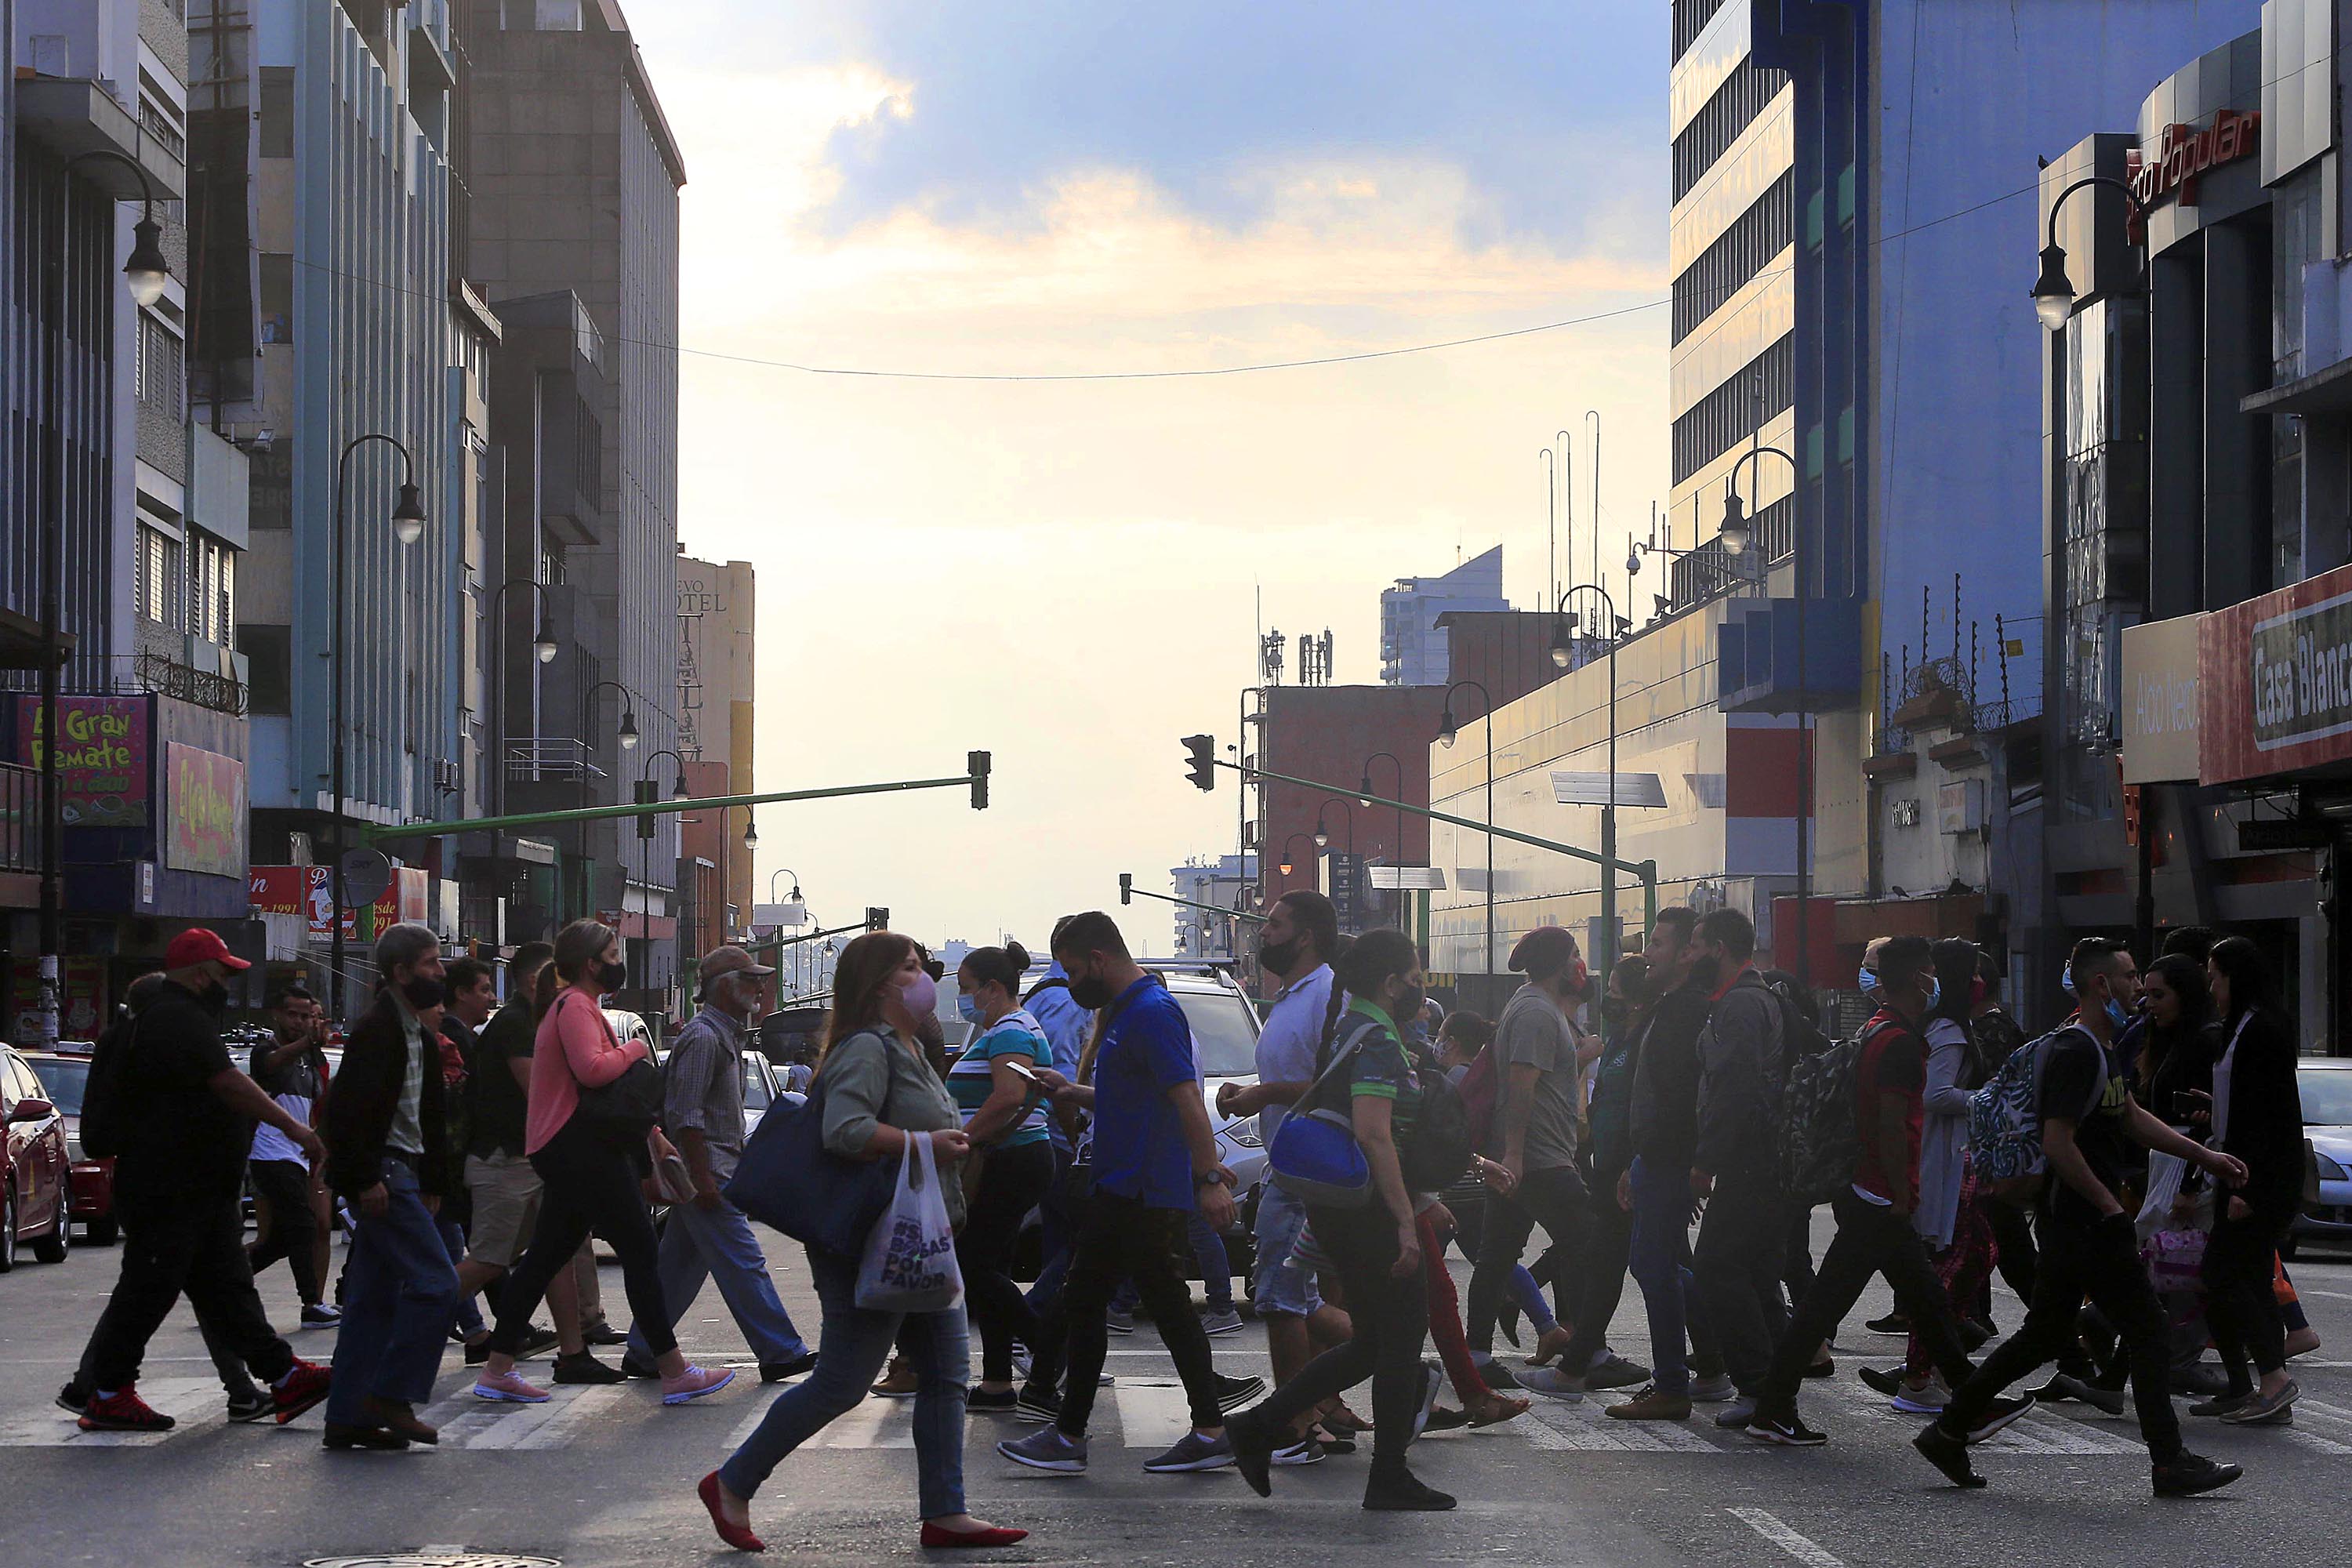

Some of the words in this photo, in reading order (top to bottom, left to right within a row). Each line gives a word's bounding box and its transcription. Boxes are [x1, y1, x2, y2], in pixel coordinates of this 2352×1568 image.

[2158, 109, 2261, 206] Popular
[677, 580, 704, 593] EVO
[677, 593, 727, 612] TEL
[2256, 647, 2295, 728] Casa
[2298, 630, 2352, 717] Blanc
[2136, 672, 2163, 735] Aldo
[273, 903, 296, 914] 1991
[374, 902, 395, 914] esde
[374, 916, 391, 930] 91
